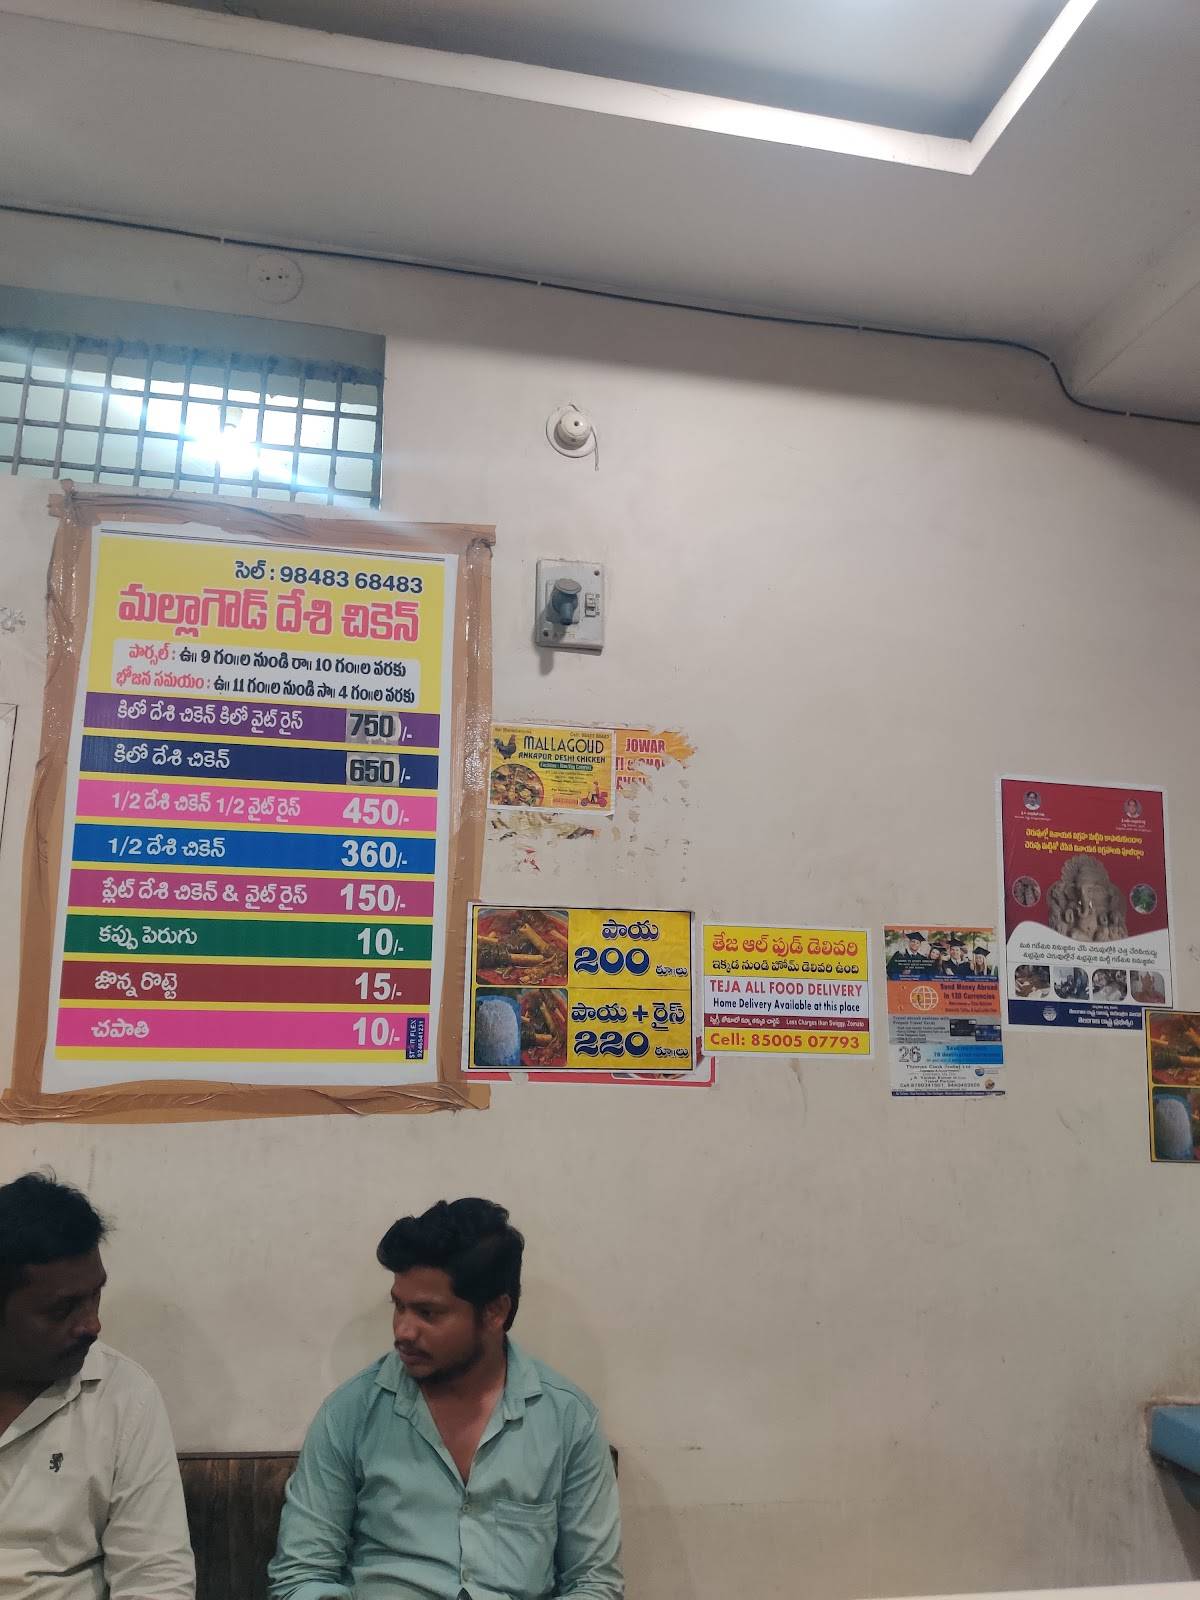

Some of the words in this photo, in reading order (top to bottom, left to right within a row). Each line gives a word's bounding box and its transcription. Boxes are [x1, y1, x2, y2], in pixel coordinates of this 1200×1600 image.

[280, 566, 349, 587] 98483
[354, 575, 423, 594] 68483
[119, 583, 268, 637] మల్లాగౌడ్
[276, 588, 332, 635] దేశి
[341, 599, 419, 642] చికెన్
[201, 650, 210, 662] 9
[254, 652, 289, 669] నుండి
[315, 658, 332, 671] 10
[374, 661, 407, 677] వరకు
[116, 665, 151, 688] భోజన
[233, 679, 243, 691] 11
[283, 680, 314, 697] నుండి
[339, 687, 347, 699] 4
[386, 689, 415, 704] వరకు
[117, 699, 147, 720] కిలో
[150, 700, 178, 723] దేశి
[181, 705, 216, 725] చికెన్
[219, 706, 248, 728] కిలో
[251, 708, 278, 734] వైట్
[279, 709, 304, 735] రైస్
[114, 742, 148, 765] కిలో
[152, 742, 182, 767] దేశి
[187, 748, 231, 768] చికెన్
[519, 752, 552, 760] ANKAPUR
[555, 754, 575, 762] DESHI
[577, 755, 606, 763] CHICKEN
[524, 735, 604, 754] MALLAGOUD
[112, 792, 139, 810] 1/2
[144, 789, 171, 811] దేశి
[173, 793, 212, 814] చికెన్
[216, 796, 244, 816] 1/2
[248, 796, 274, 822] వైట్
[275, 798, 301, 822] రైస్
[108, 837, 142, 857] 1/2
[147, 835, 178, 858] దేశి
[181, 838, 225, 858] చికెన్
[101, 877, 135, 905] ప్లేట్
[139, 880, 170, 902] దేశి
[175, 883, 217, 903] చికెన్
[222, 885, 239, 903] &
[245, 883, 277, 910] వైట్
[280, 885, 308, 911] రైస్
[98, 925, 138, 951] కప్పు
[142, 925, 197, 947] పెరుగు
[601, 919, 659, 941] పాయ
[712, 931, 738, 952] తేజ
[743, 935, 769, 953] ఆల్
[807, 938, 858, 956] డెలివరి
[573, 945, 651, 977] 200
[712, 960, 739, 973] ఇక్కడ
[741, 960, 769, 971] నుండి
[802, 962, 833, 973] డెలివరి
[836, 962, 859, 974] ఉంది
[141, 971, 178, 1000] రొట్టె
[710, 980, 740, 993] TEJA
[745, 981, 766, 994] ALL
[770, 982, 803, 995] FOOD
[808, 984, 862, 997] DELIVERY
[571, 1002, 628, 1025] పాయ
[632, 1004, 649, 1022] +
[651, 1001, 686, 1032] రైస్
[713, 998, 736, 1008] Home
[739, 999, 772, 1012] Delivery
[774, 1000, 811, 1010] Available
[814, 1002, 822, 1010] at
[824, 1002, 837, 1011] this
[839, 1002, 860, 1013] place
[91, 1020, 150, 1040] చపాతి
[798, 1019, 817, 1027] Charges
[573, 1029, 650, 1058] 220
[710, 1033, 745, 1046] Cell:
[751, 1034, 802, 1048] 85005
[808, 1036, 859, 1049] 07793
